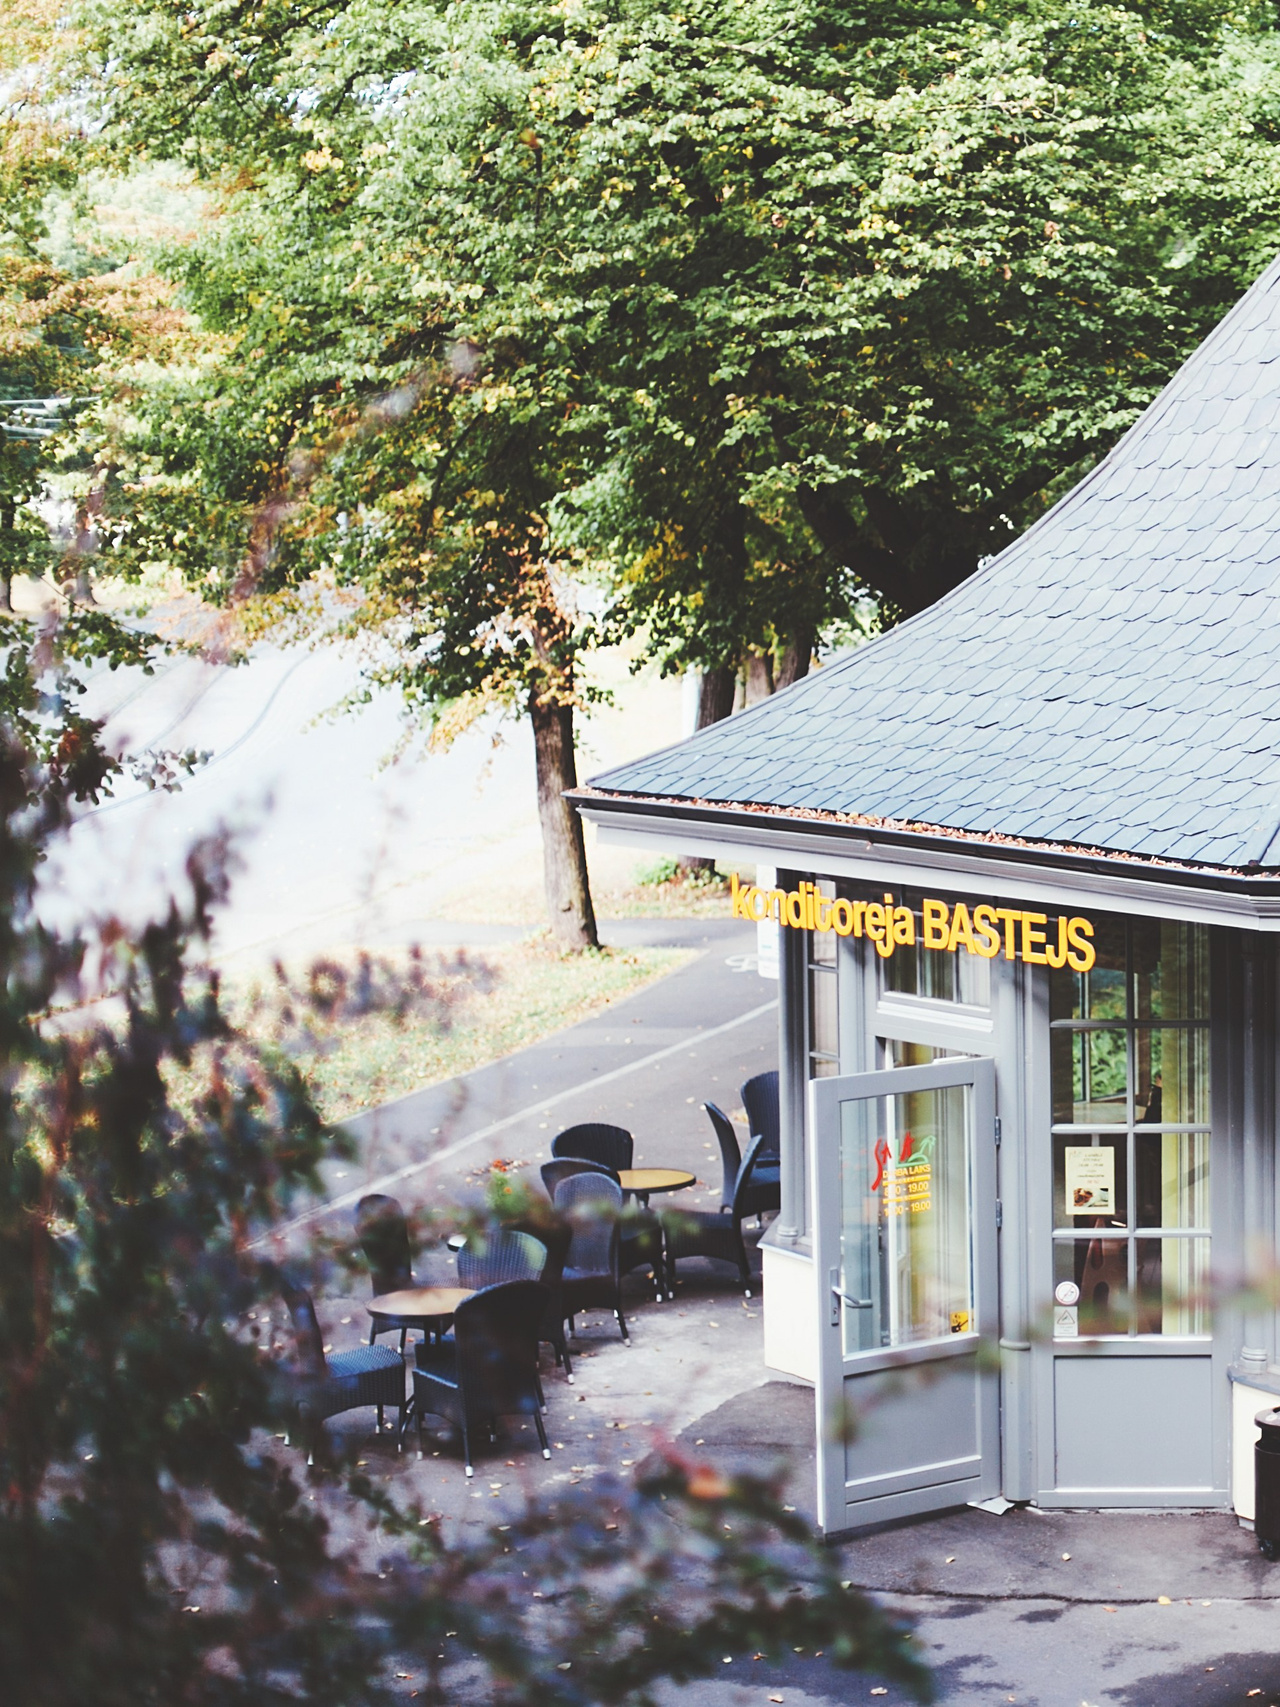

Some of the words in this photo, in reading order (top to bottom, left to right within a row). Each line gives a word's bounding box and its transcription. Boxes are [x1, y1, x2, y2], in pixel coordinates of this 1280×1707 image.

[731, 872, 915, 958] konditoreja
[923, 898, 1097, 972] BASTEJS
[909, 1163, 931, 1175] LAIKS
[908, 1181, 929, 1193] 19.00
[911, 1200, 931, 1212] 19.00
